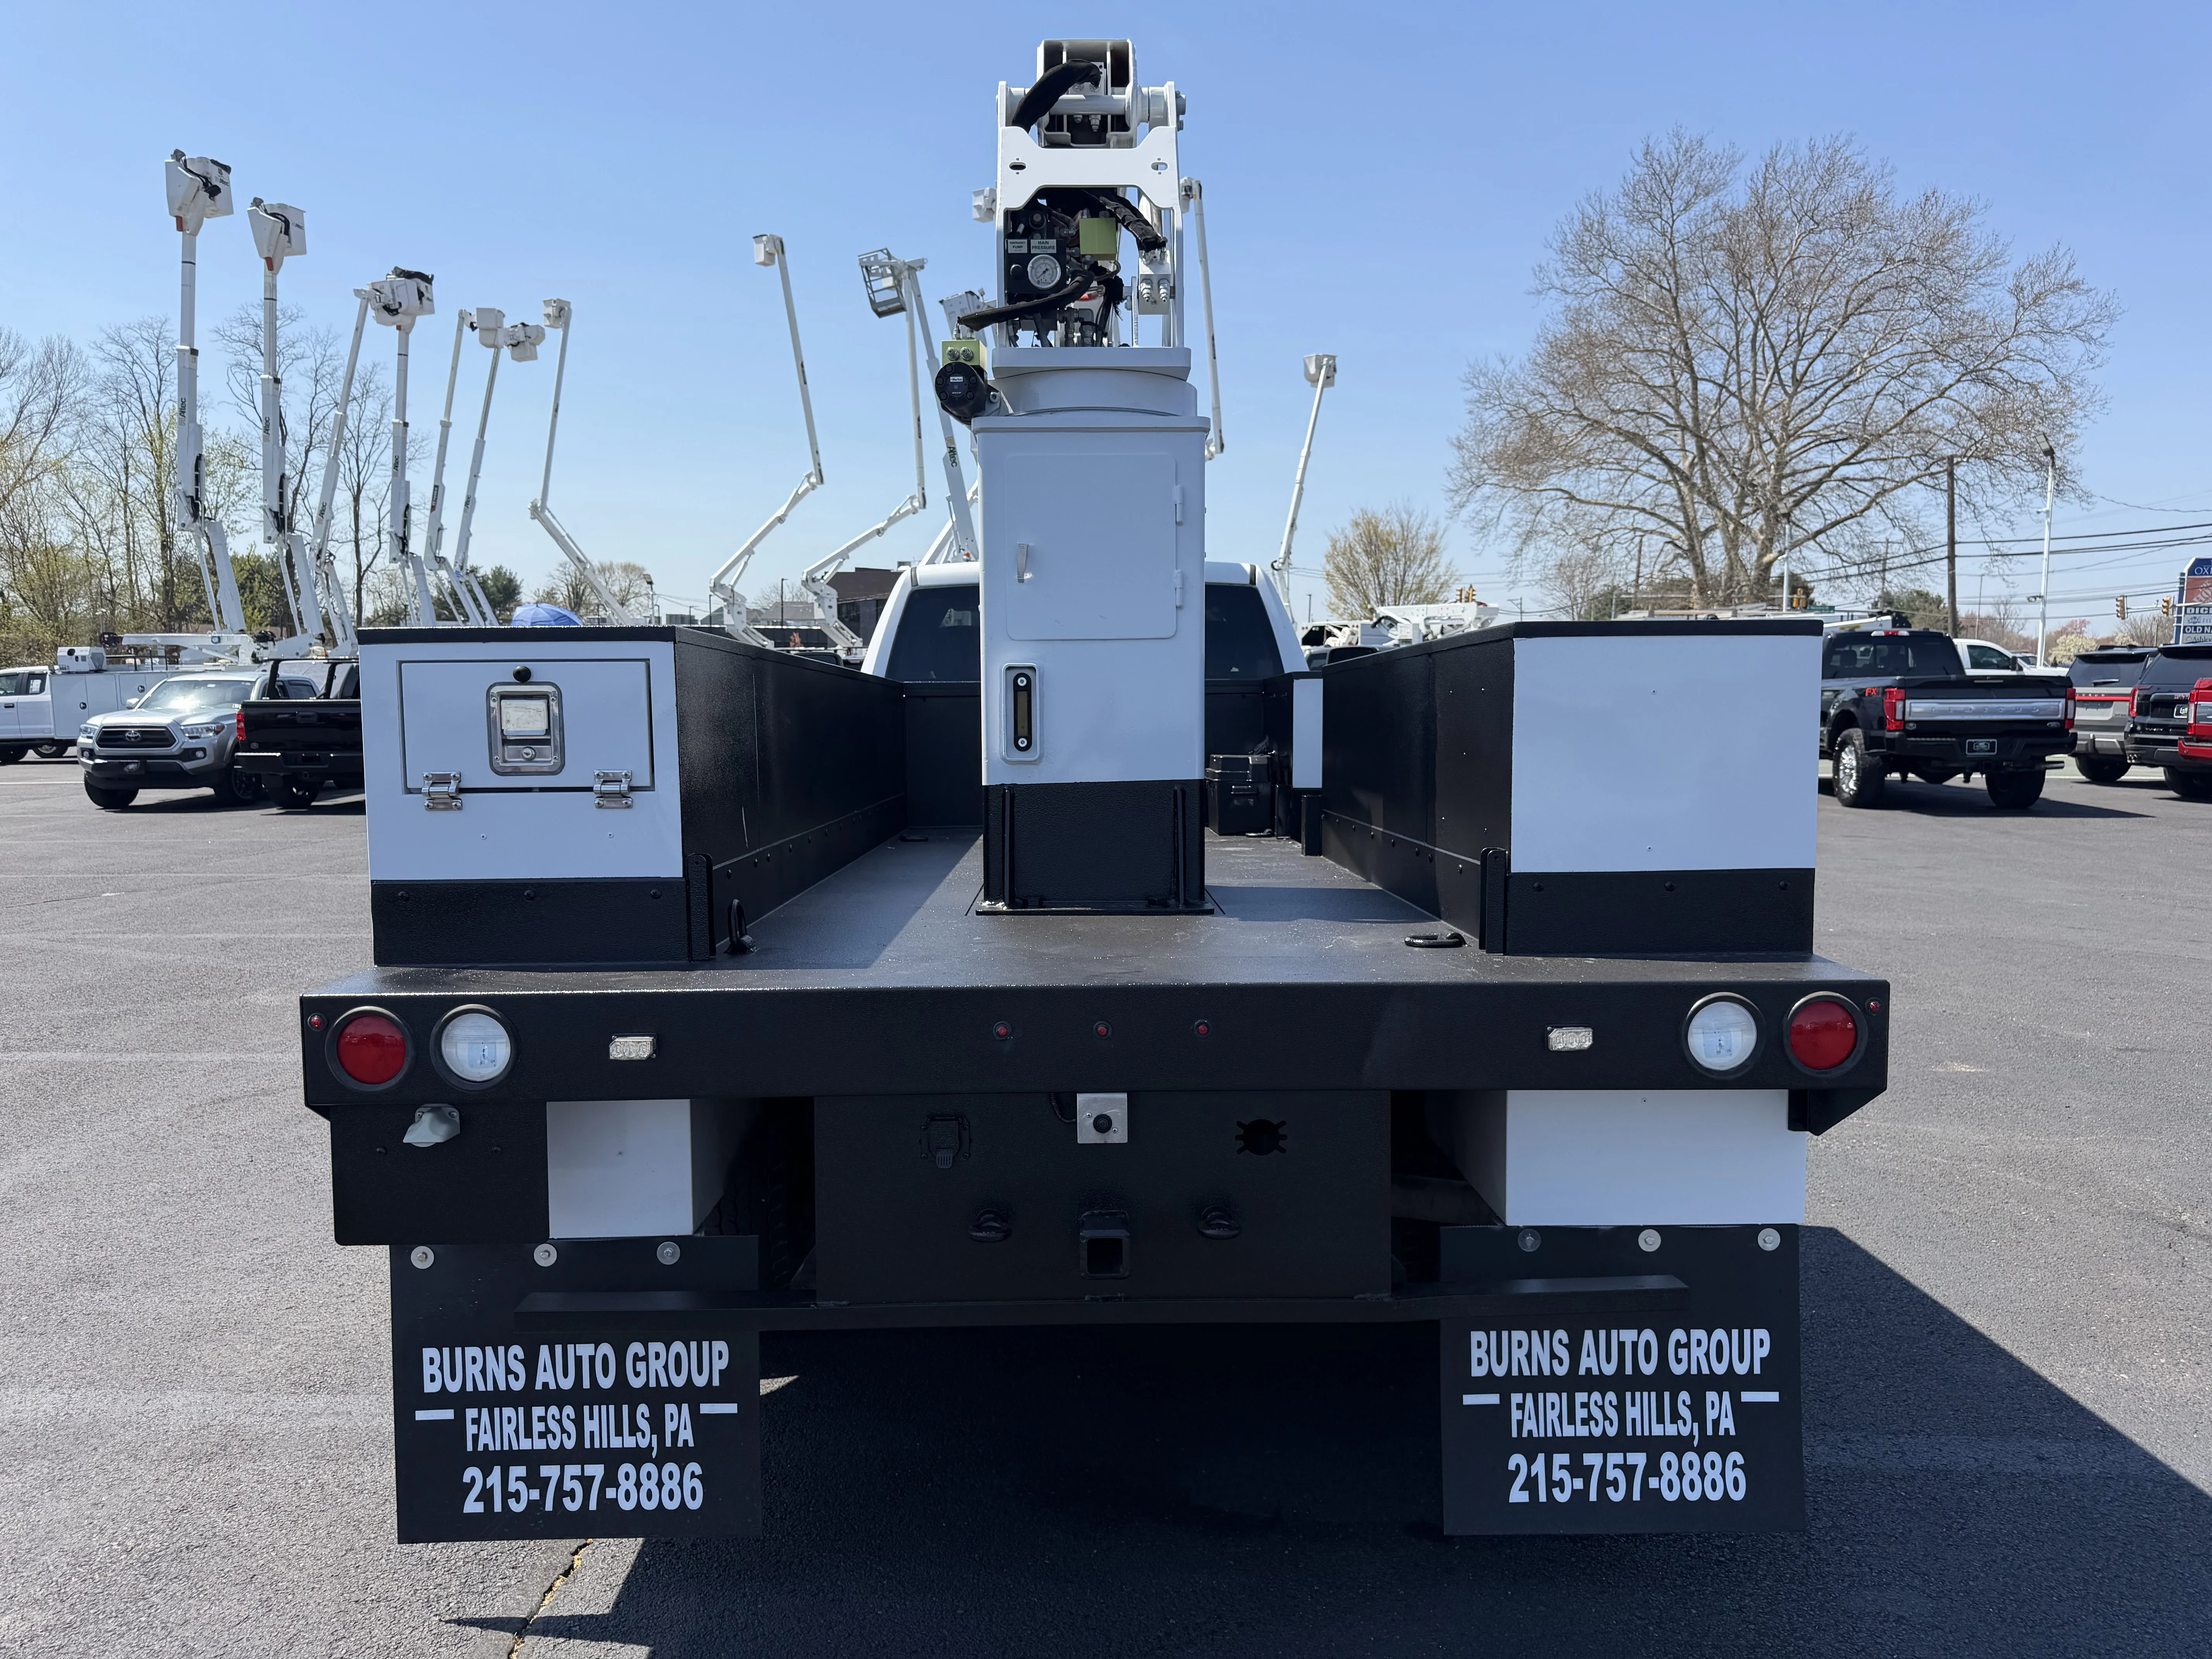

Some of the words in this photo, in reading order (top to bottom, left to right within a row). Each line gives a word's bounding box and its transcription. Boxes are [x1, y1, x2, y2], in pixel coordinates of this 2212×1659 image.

[947, 446, 957, 467] Altec
[422, 1345, 526, 1393] BURNS
[535, 1343, 616, 1390] AUTO
[626, 1341, 729, 1388] GROUP
[1470, 1329, 1570, 1377] BURNS
[1578, 1328, 1658, 1376] AUTO
[1668, 1328, 1770, 1375] GROUP
[465, 1405, 576, 1451] FAIRLESS
[583, 1403, 657, 1459] HILLS,
[665, 1403, 694, 1447] PA
[1511, 1391, 1618, 1438] FAIRLESS
[1625, 1391, 1698, 1447] HILLS,
[1705, 1391, 1736, 1436] PA
[463, 1462, 703, 1513] 215-757-8886
[1508, 1451, 1746, 1503] 215-757-8886
